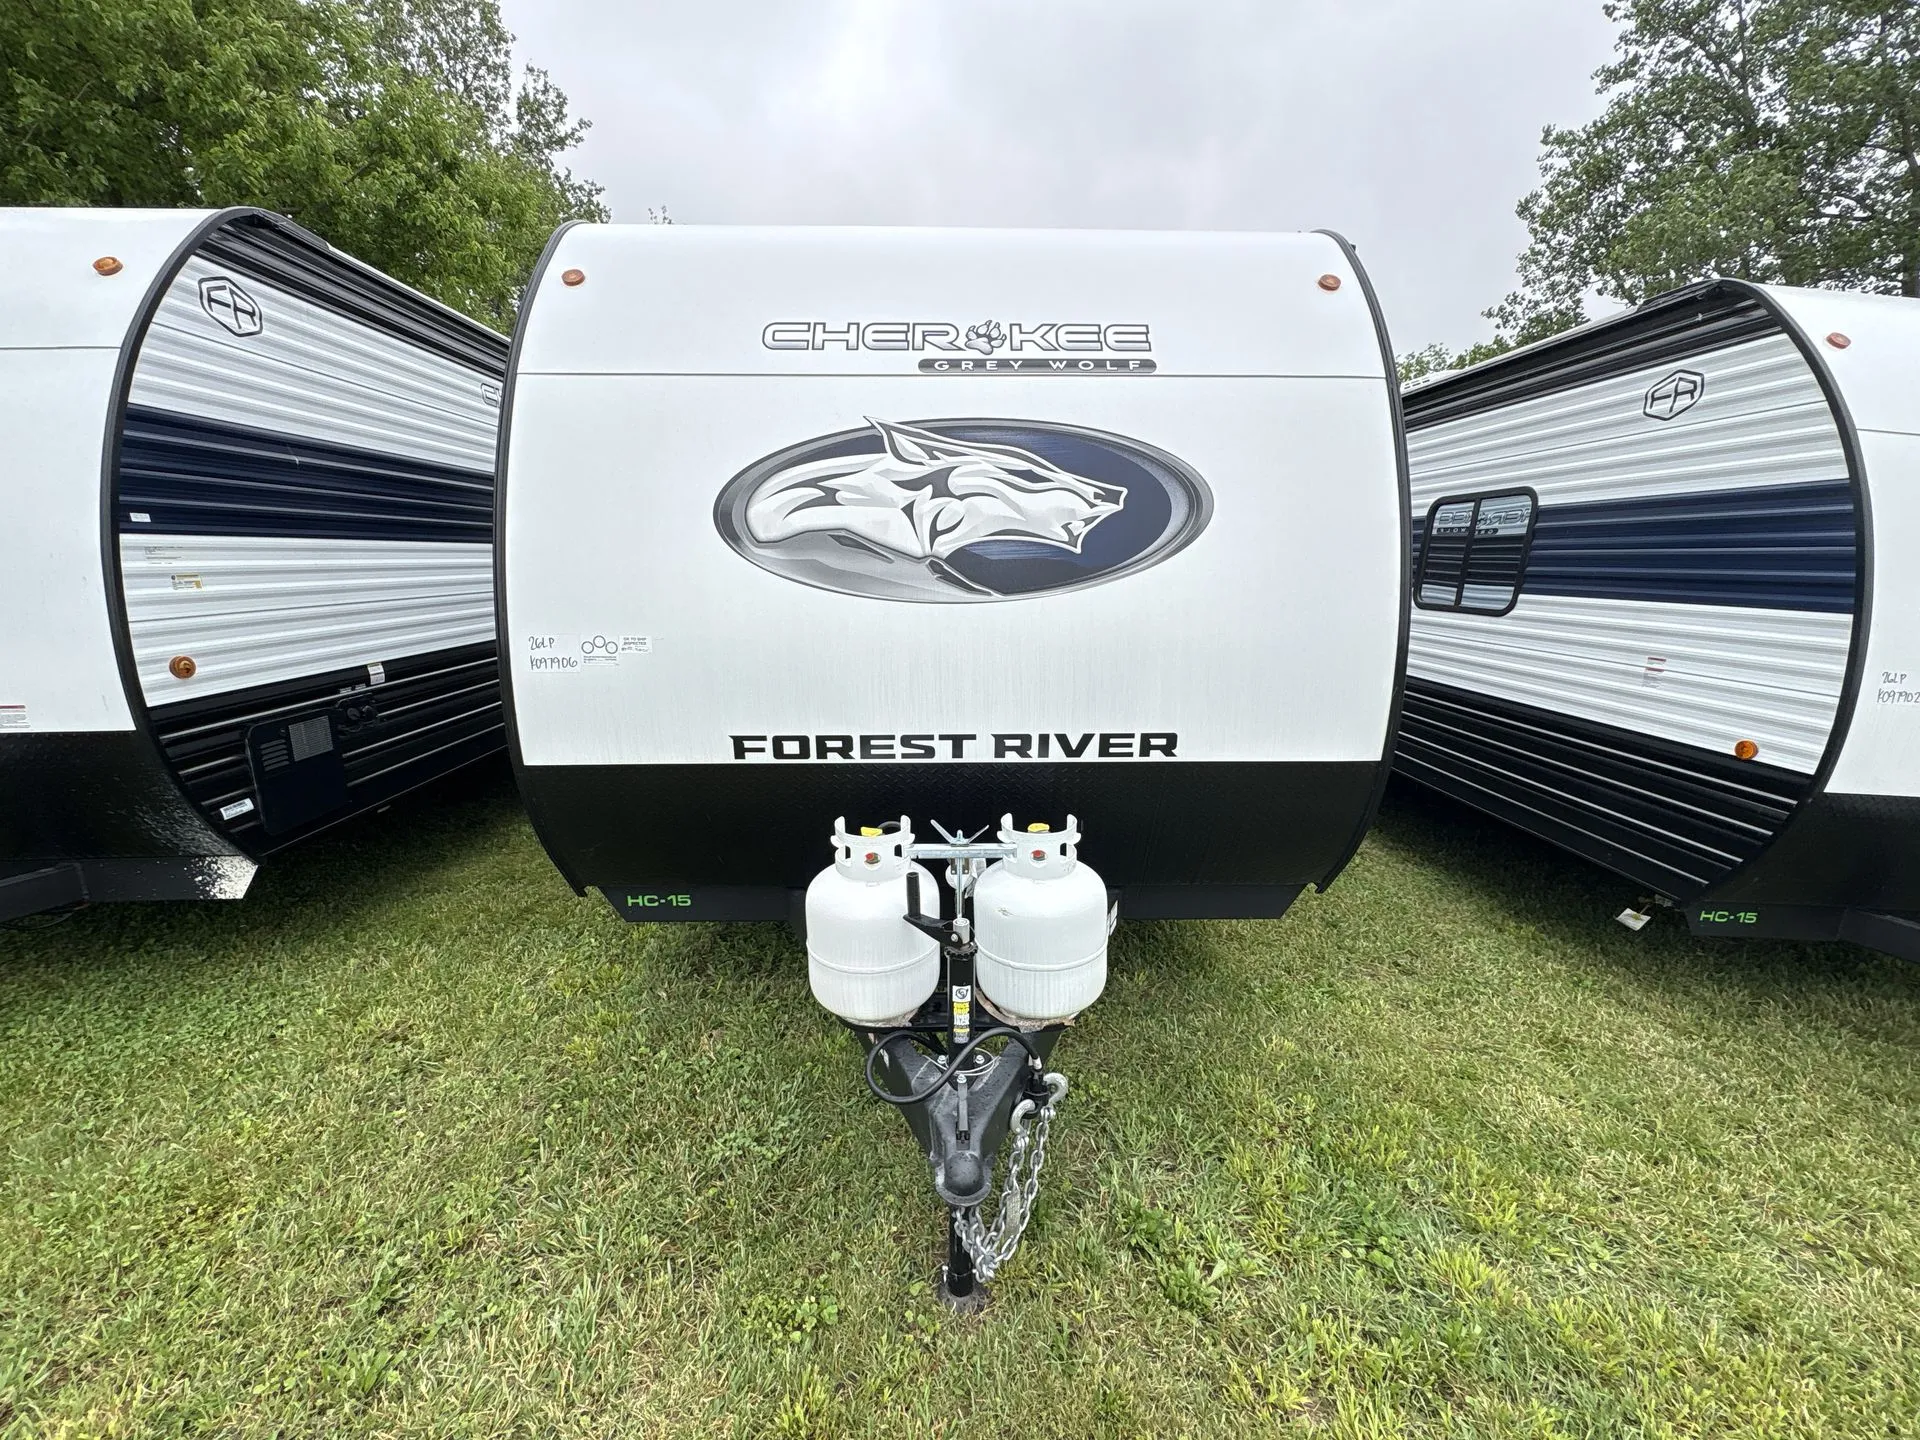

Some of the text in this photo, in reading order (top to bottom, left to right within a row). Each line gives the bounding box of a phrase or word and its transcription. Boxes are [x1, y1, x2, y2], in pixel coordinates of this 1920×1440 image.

[934, 360, 1141, 371] GREY WOLF
[728, 732, 1179, 760] FOREST RIVER
[626, 894, 692, 907] HC-15
[1699, 910, 1759, 924] HC-15
